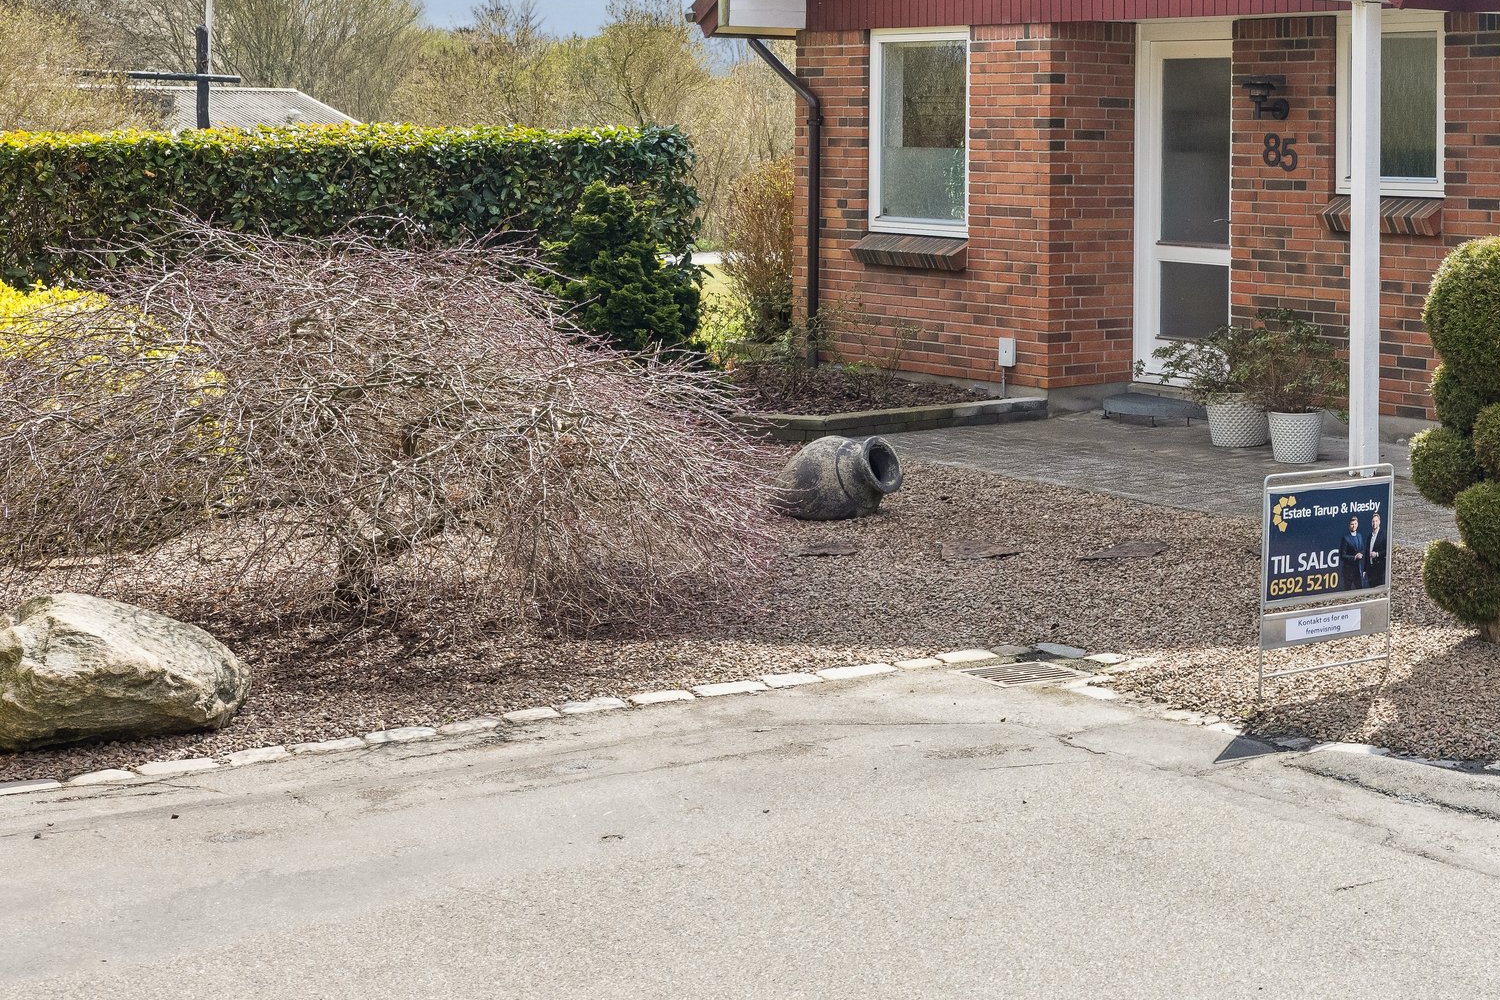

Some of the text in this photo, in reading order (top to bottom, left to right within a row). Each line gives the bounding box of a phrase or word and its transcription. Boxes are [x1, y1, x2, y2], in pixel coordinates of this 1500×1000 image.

[1263, 133, 1298, 172] 85
[1282, 499, 1381, 519] Estate Tarup & Næsby
[1270, 548, 1340, 575] TIL SALG
[1270, 572, 1339, 596] 6592 5210
[1298, 616, 1322, 626] Kontakt
[1331, 614, 1340, 622] for
[1305, 625, 1341, 635] fremvisning
